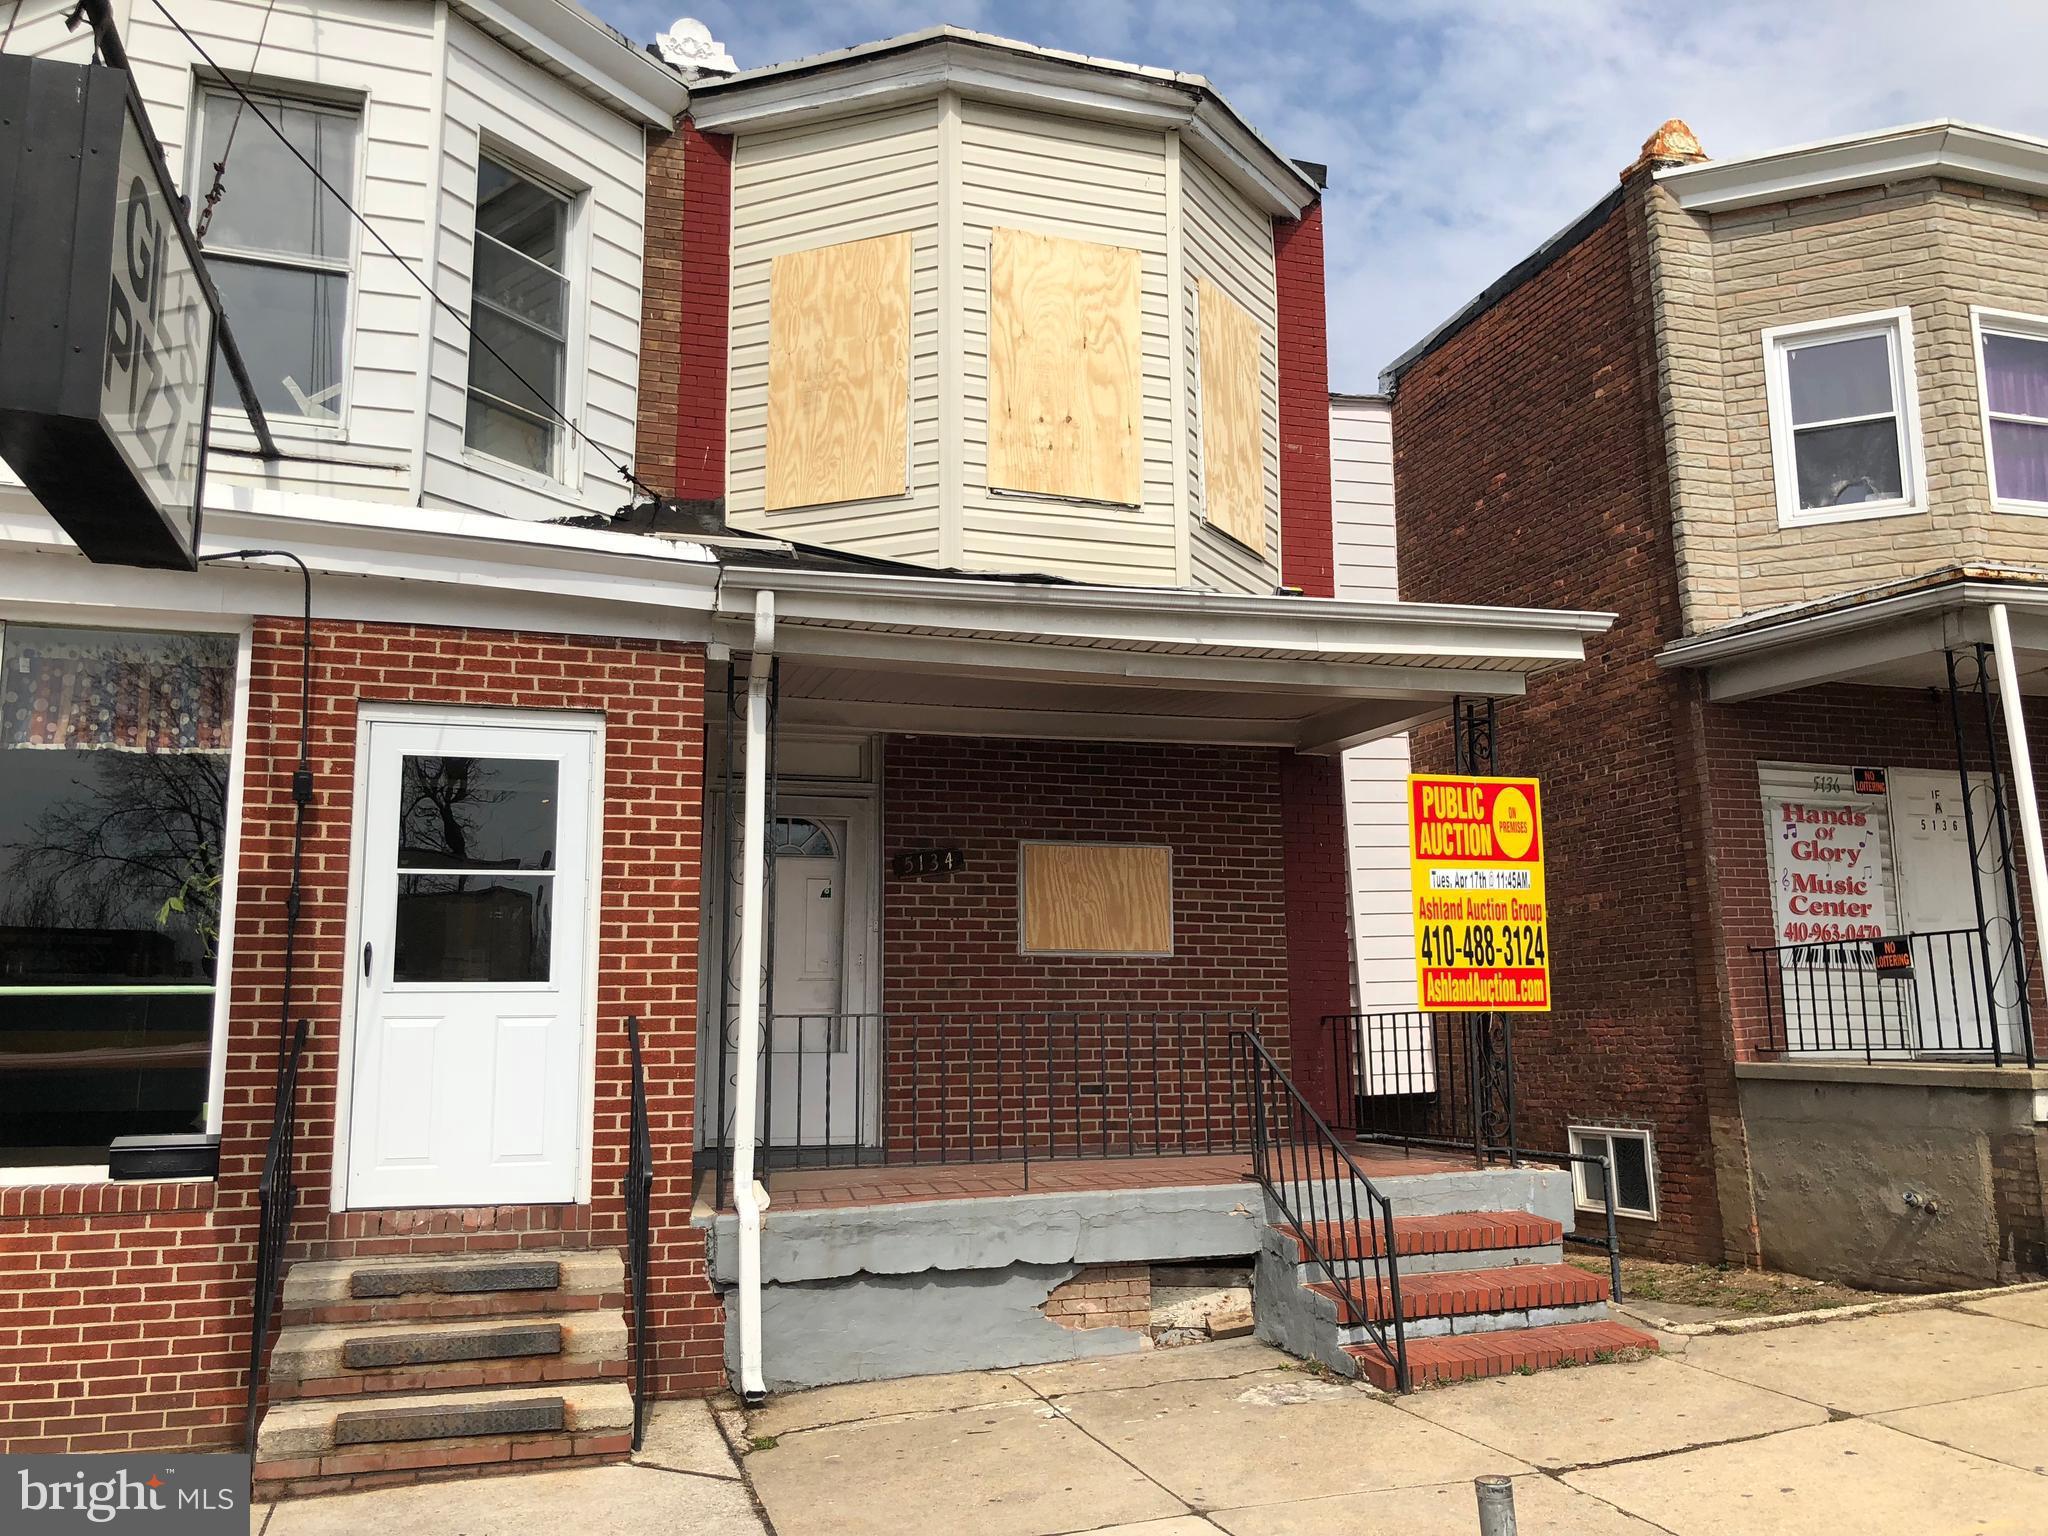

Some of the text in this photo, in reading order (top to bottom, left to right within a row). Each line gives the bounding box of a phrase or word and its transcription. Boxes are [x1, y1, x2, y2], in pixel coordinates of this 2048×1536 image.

[1813, 776, 1841, 794] 5136
[1855, 780, 1886, 793] LOITERING
[1864, 771, 1875, 781] NO
[1422, 785, 1484, 820] PUBLIC
[1508, 806, 1517, 818] ON
[1934, 802, 1943, 815] A
[1781, 803, 1867, 827] Hands
[1499, 820, 1528, 834] PREMISES
[1814, 826, 1836, 841] Of
[1420, 822, 1493, 856] AUCTION
[904, 852, 953, 873] 5134
[1791, 840, 1862, 868] Glory
[1455, 871, 1468, 888] Apr
[1470, 871, 1487, 888] 17th
[1791, 873, 1868, 896] Music
[1419, 896, 1543, 923] Ashland Auction Group
[1788, 895, 1873, 918] Center
[1783, 921, 1881, 944] 410-963-0470
[1421, 924, 1545, 967] 410-488-3124
[1884, 942, 1896, 954] NO
[1876, 953, 1910, 968] LOITERING
[1427, 971, 1545, 1003] AshlandAuction.com
